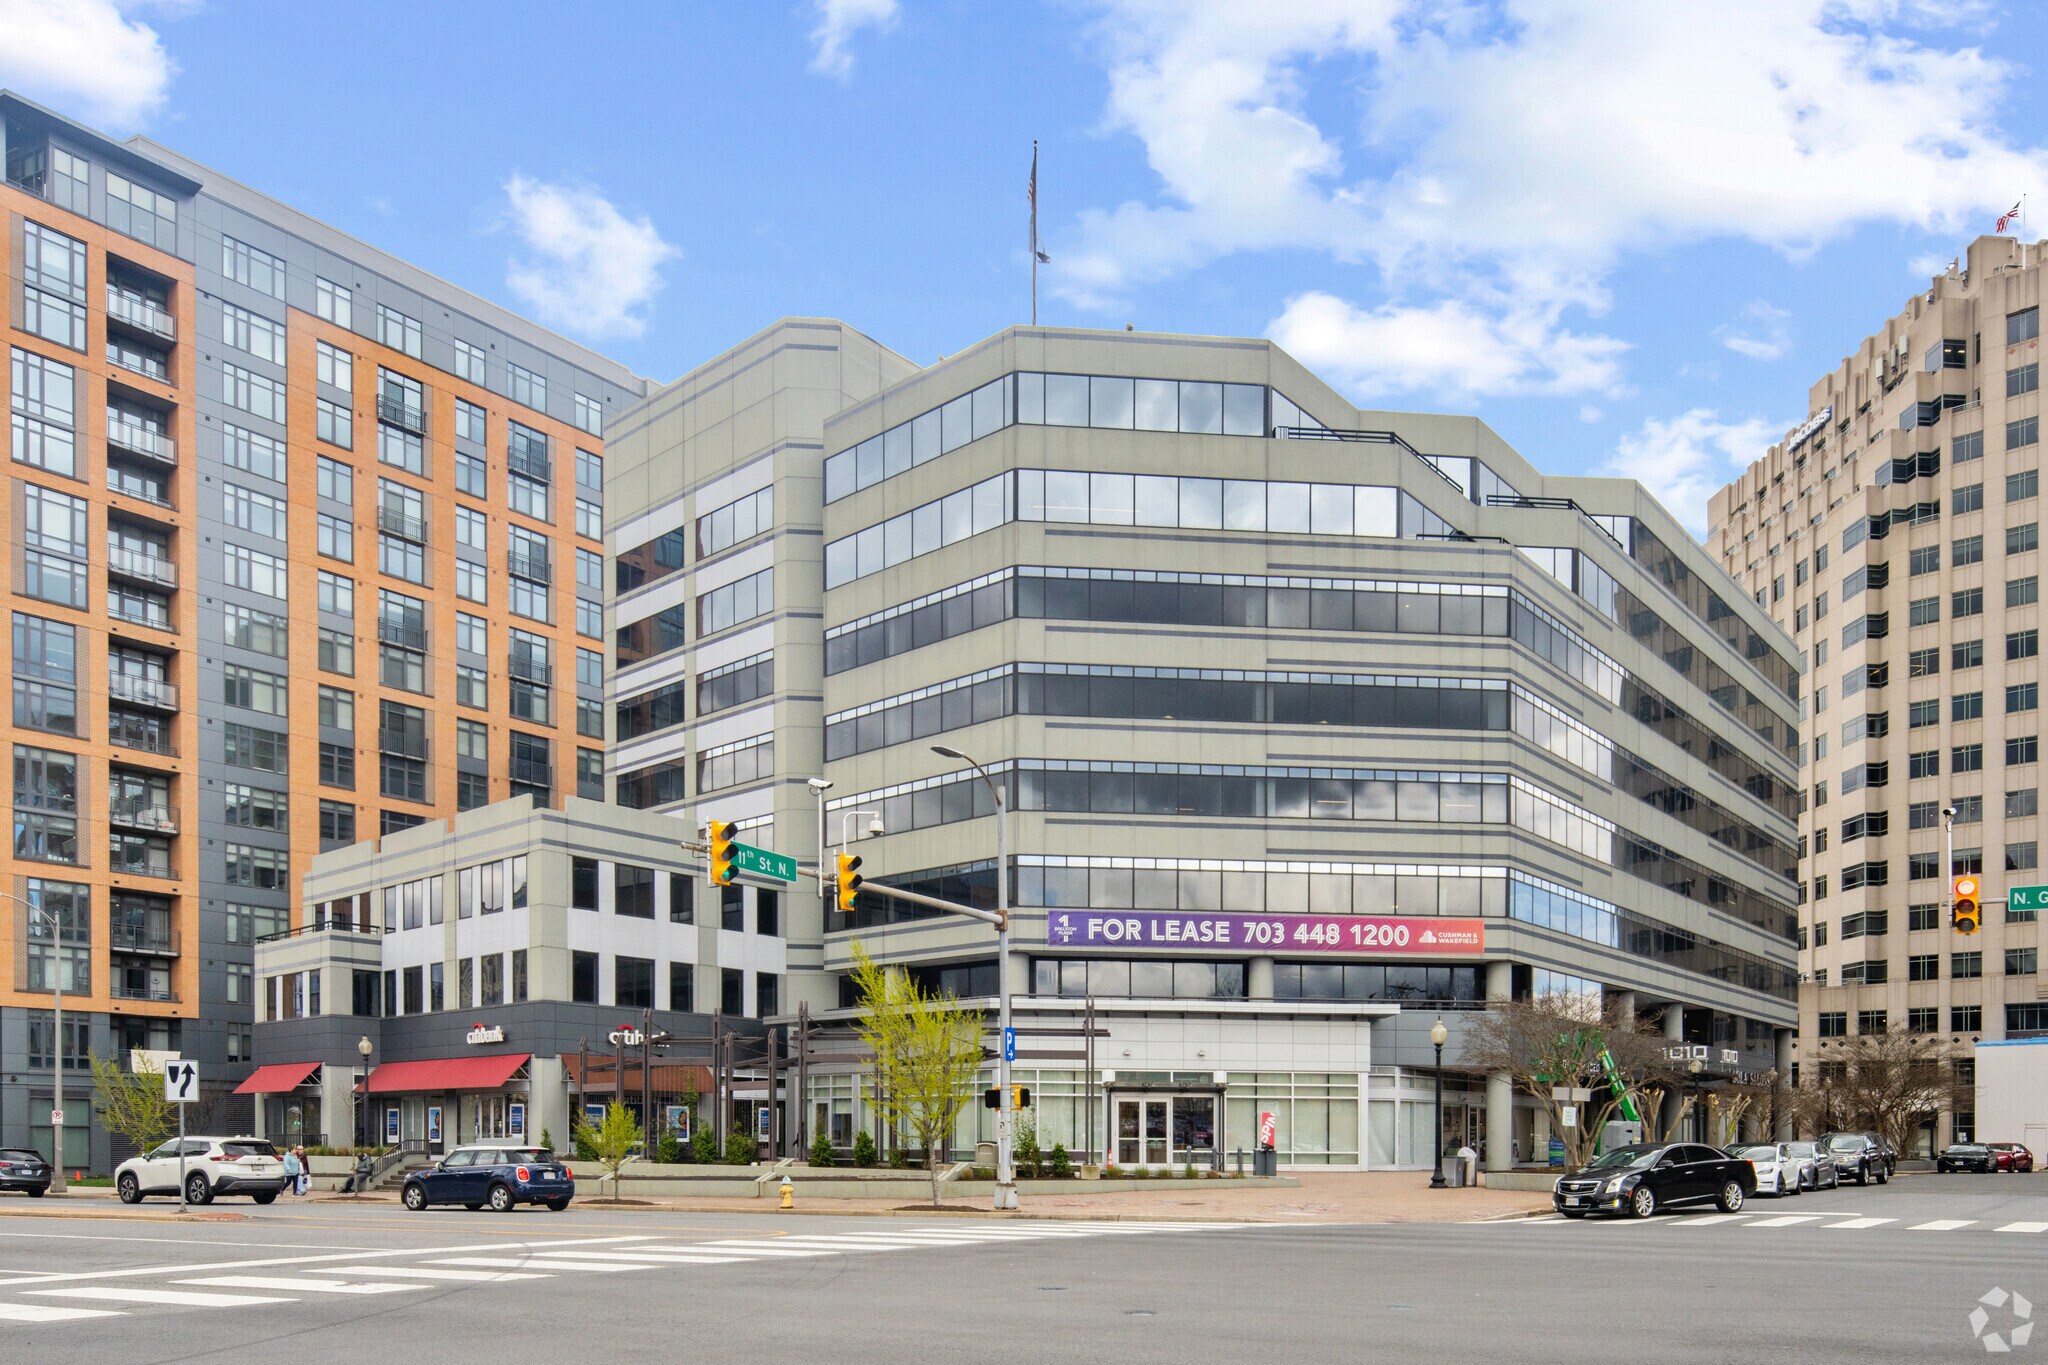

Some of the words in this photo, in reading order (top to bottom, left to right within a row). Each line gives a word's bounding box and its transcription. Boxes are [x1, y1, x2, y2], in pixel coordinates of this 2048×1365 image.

[738, 850, 755, 865] 11th
[759, 856, 775, 873] St.
[778, 861, 789, 877] N.
[2013, 892, 2031, 905] N.
[1088, 917, 1141, 941] FOR
[1151, 919, 1231, 943] LEASE
[1243, 921, 1285, 944] 703
[1293, 922, 1340, 945] 448
[1349, 923, 1410, 946] 1200
[466, 1025, 505, 1044] citibank
